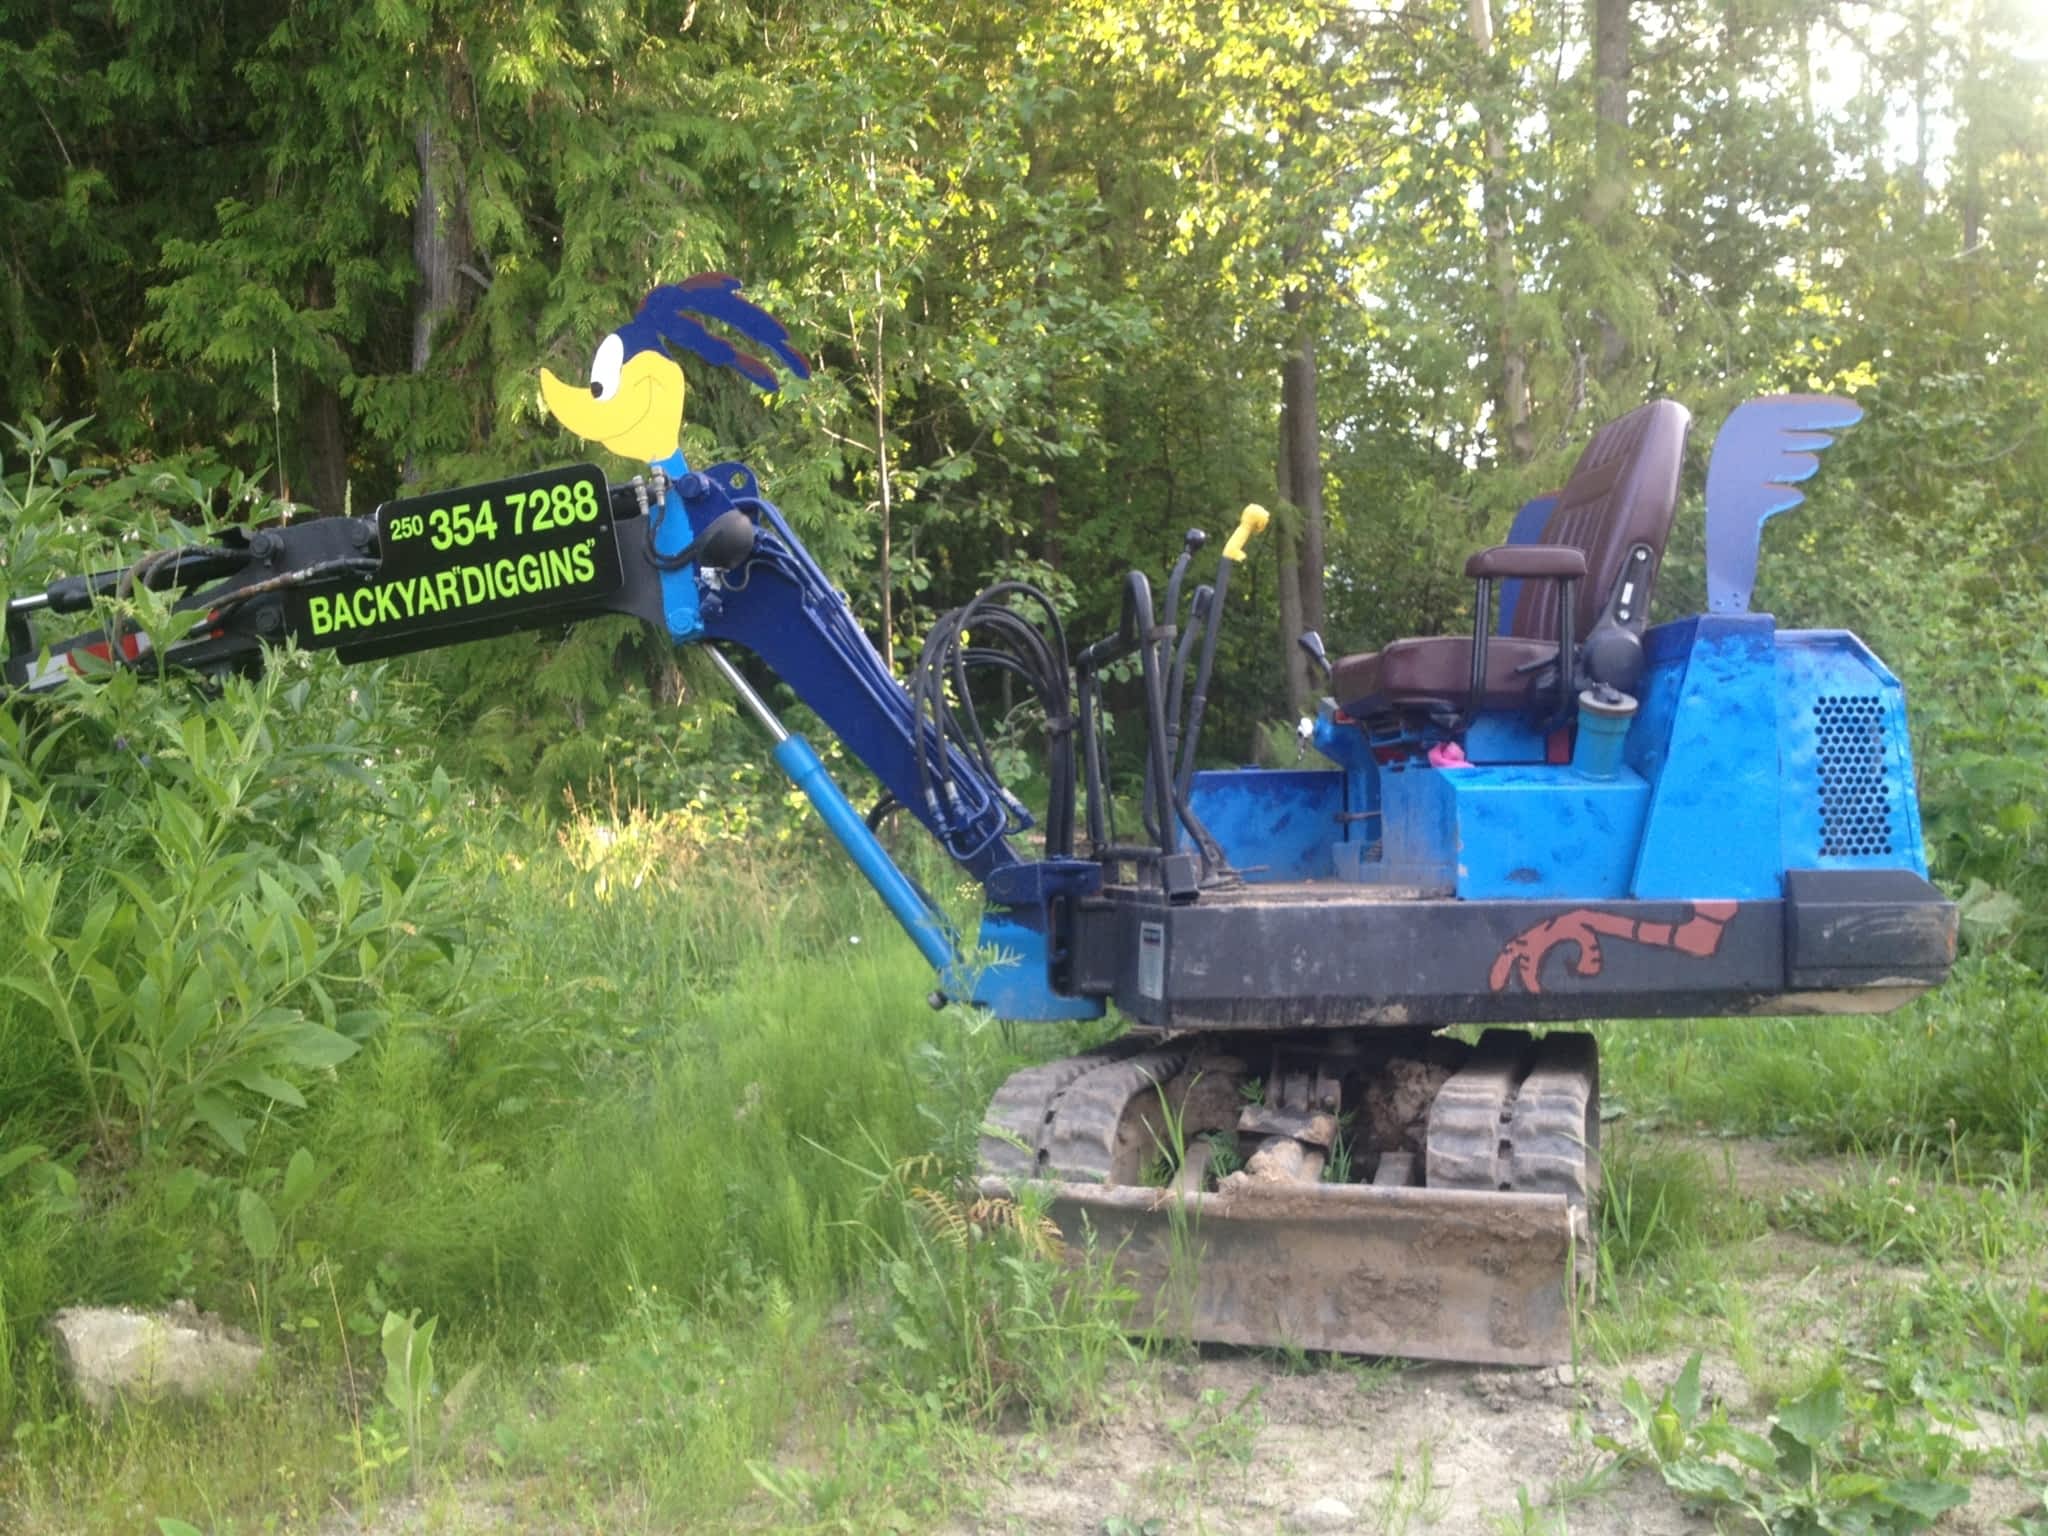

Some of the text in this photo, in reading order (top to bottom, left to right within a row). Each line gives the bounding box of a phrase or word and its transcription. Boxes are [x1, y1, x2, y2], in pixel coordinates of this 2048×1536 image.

[390, 480, 598, 550] 250 354 7288
